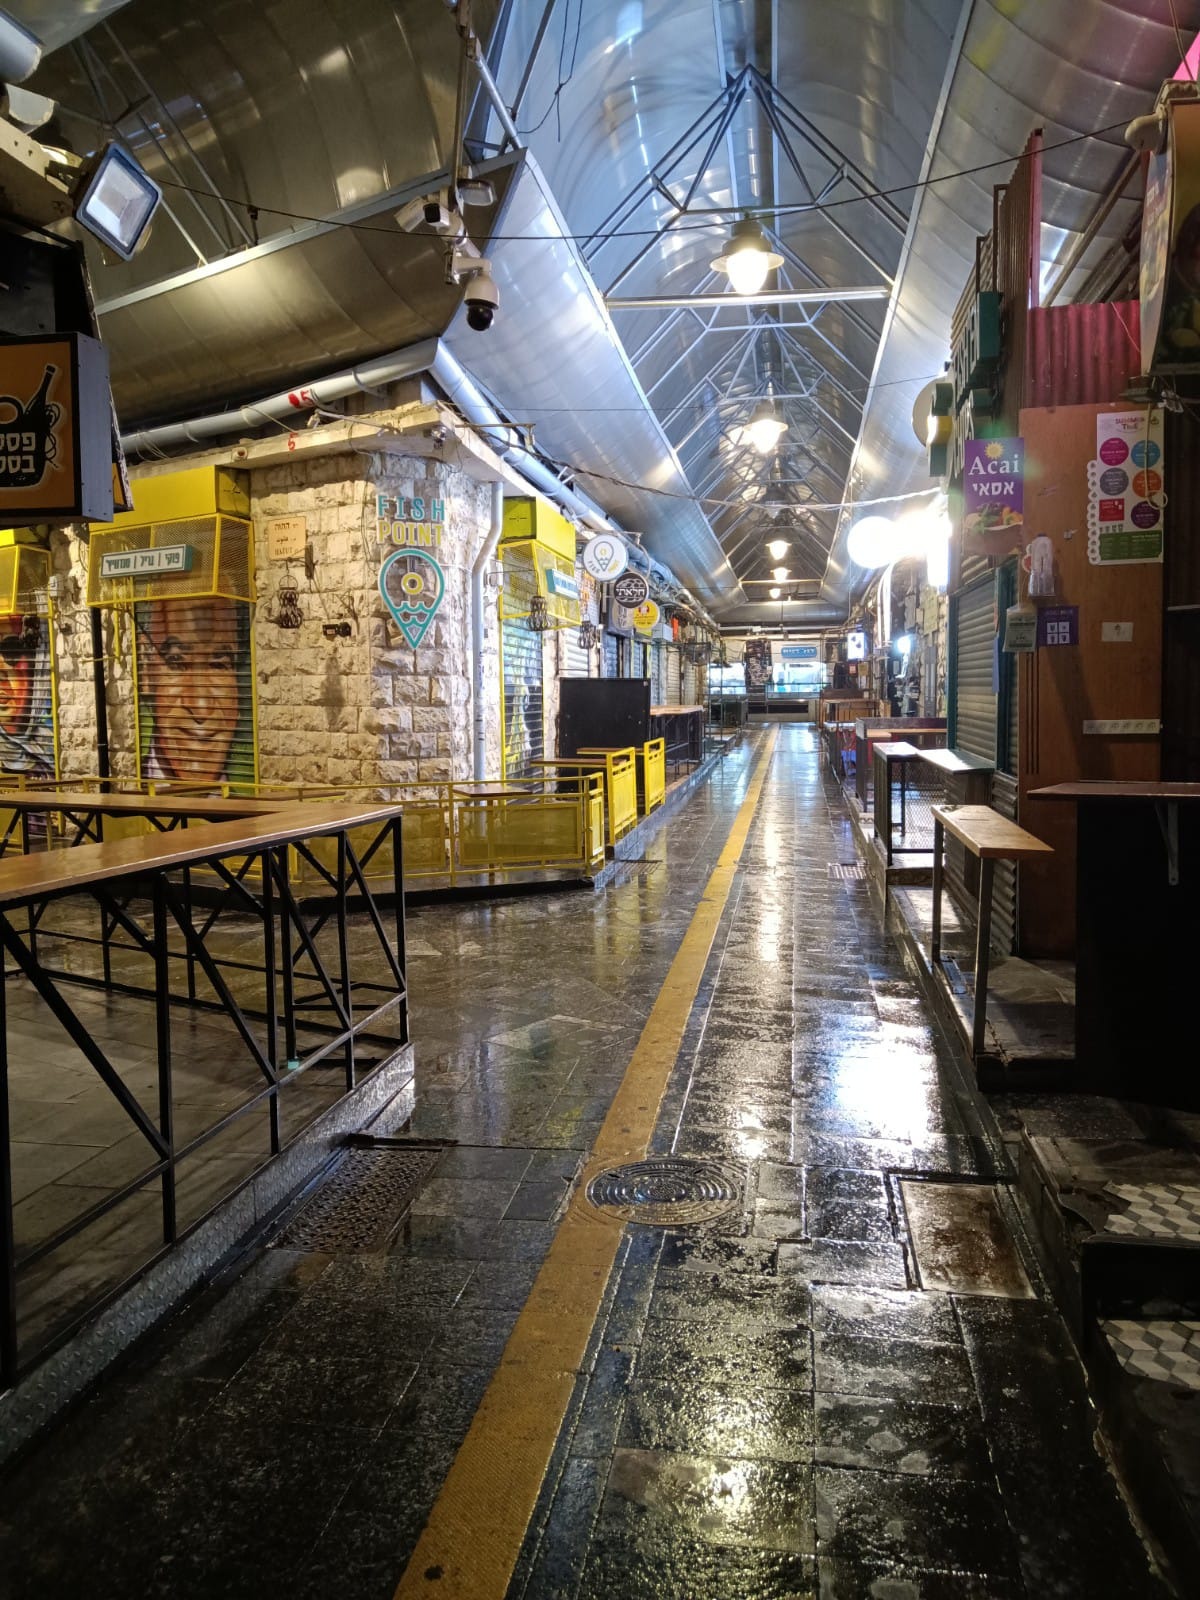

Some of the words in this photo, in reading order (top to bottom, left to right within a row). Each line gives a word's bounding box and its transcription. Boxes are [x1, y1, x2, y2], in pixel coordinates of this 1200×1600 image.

[968, 453, 1020, 476] Acai
[972, 481, 1014, 496] אסאי
[377, 494, 445, 521] FISH
[377, 521, 444, 546] POINT
